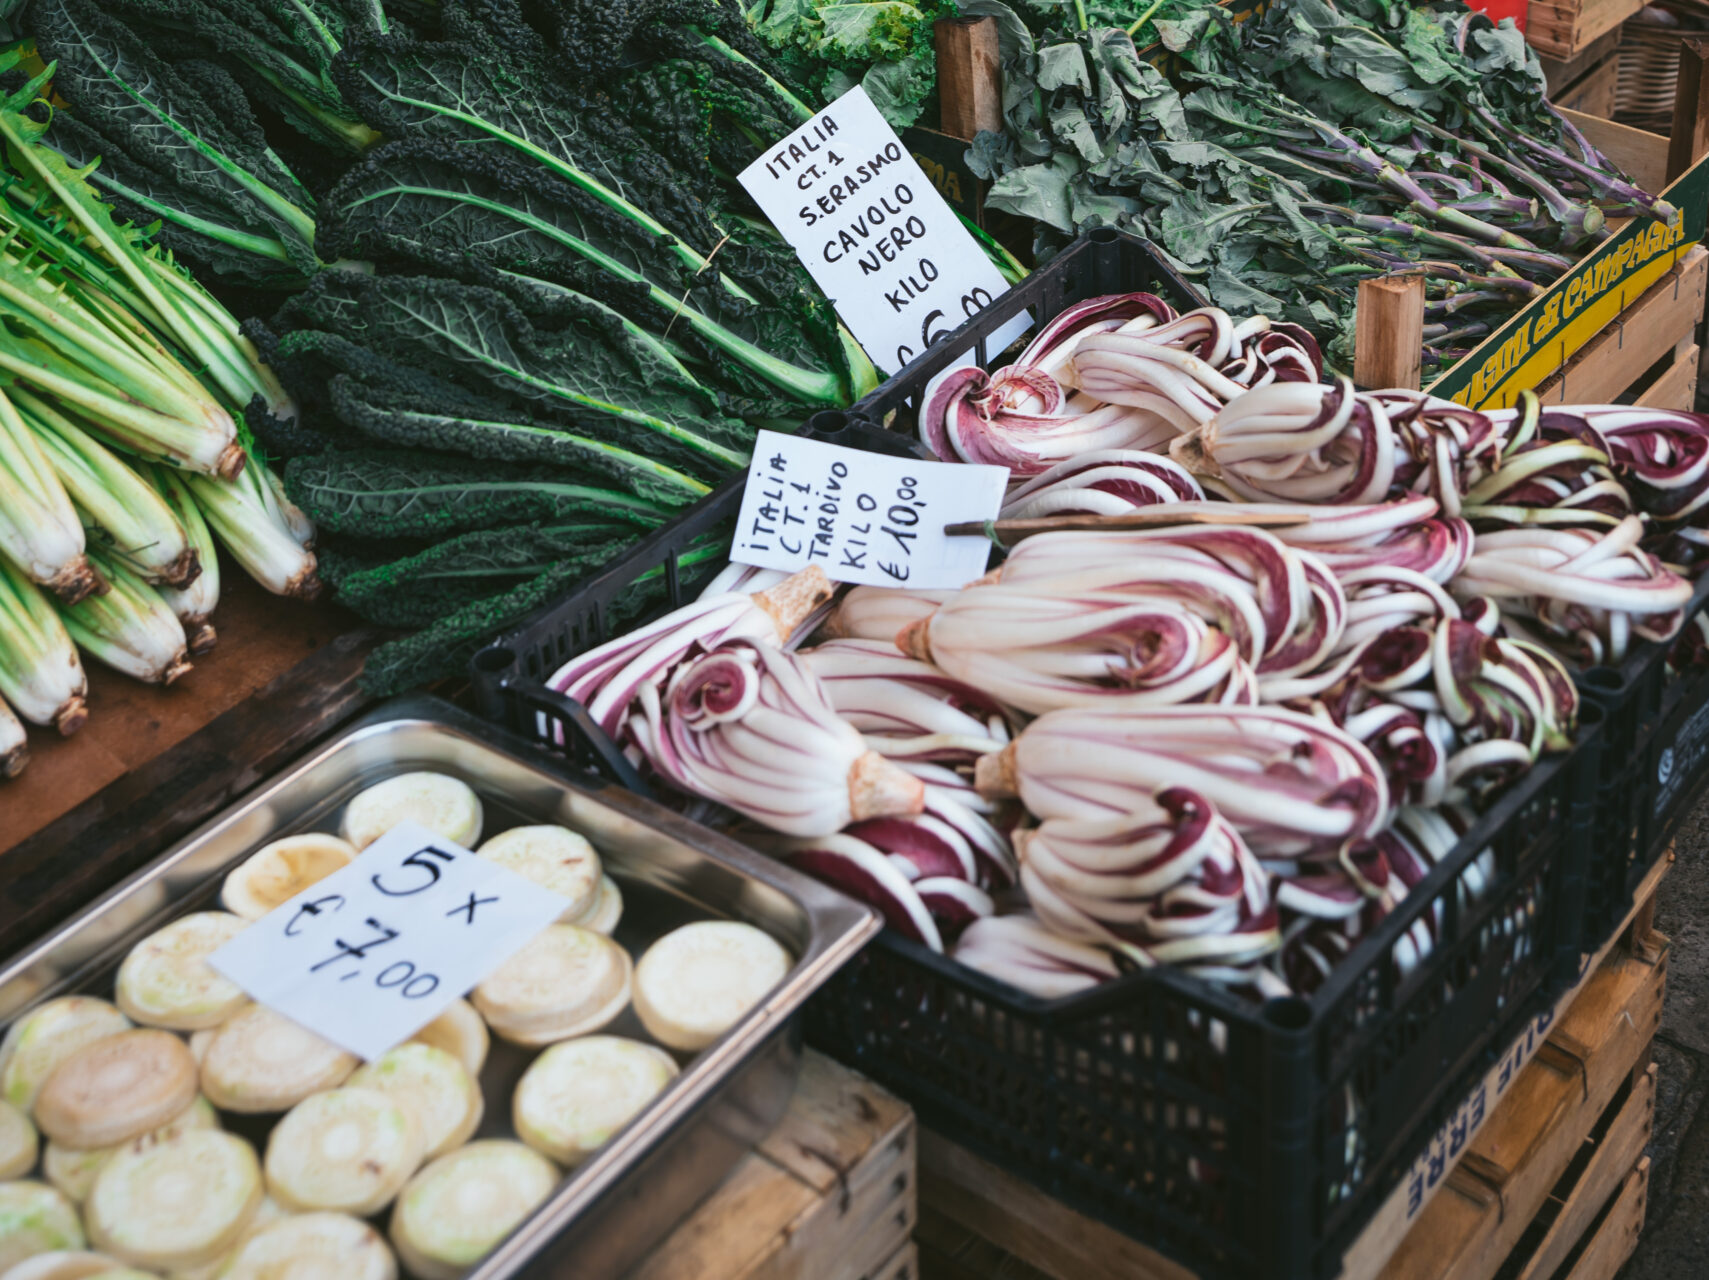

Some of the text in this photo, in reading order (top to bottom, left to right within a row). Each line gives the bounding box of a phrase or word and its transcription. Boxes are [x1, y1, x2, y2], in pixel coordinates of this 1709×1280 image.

[765, 114, 840, 180] ITALIA
[796, 150, 845, 191] CT. 1
[799, 141, 902, 227] S.ERASMO
[823, 183, 914, 264] CAVOLO
[858, 215, 927, 276] NERO
[884, 258, 940, 313] KILO
[840, 493, 877, 570] KILO
[877, 560, 910, 581] €
[371, 845, 456, 898] 5
[1406, 1085, 1487, 1220] ERRE
